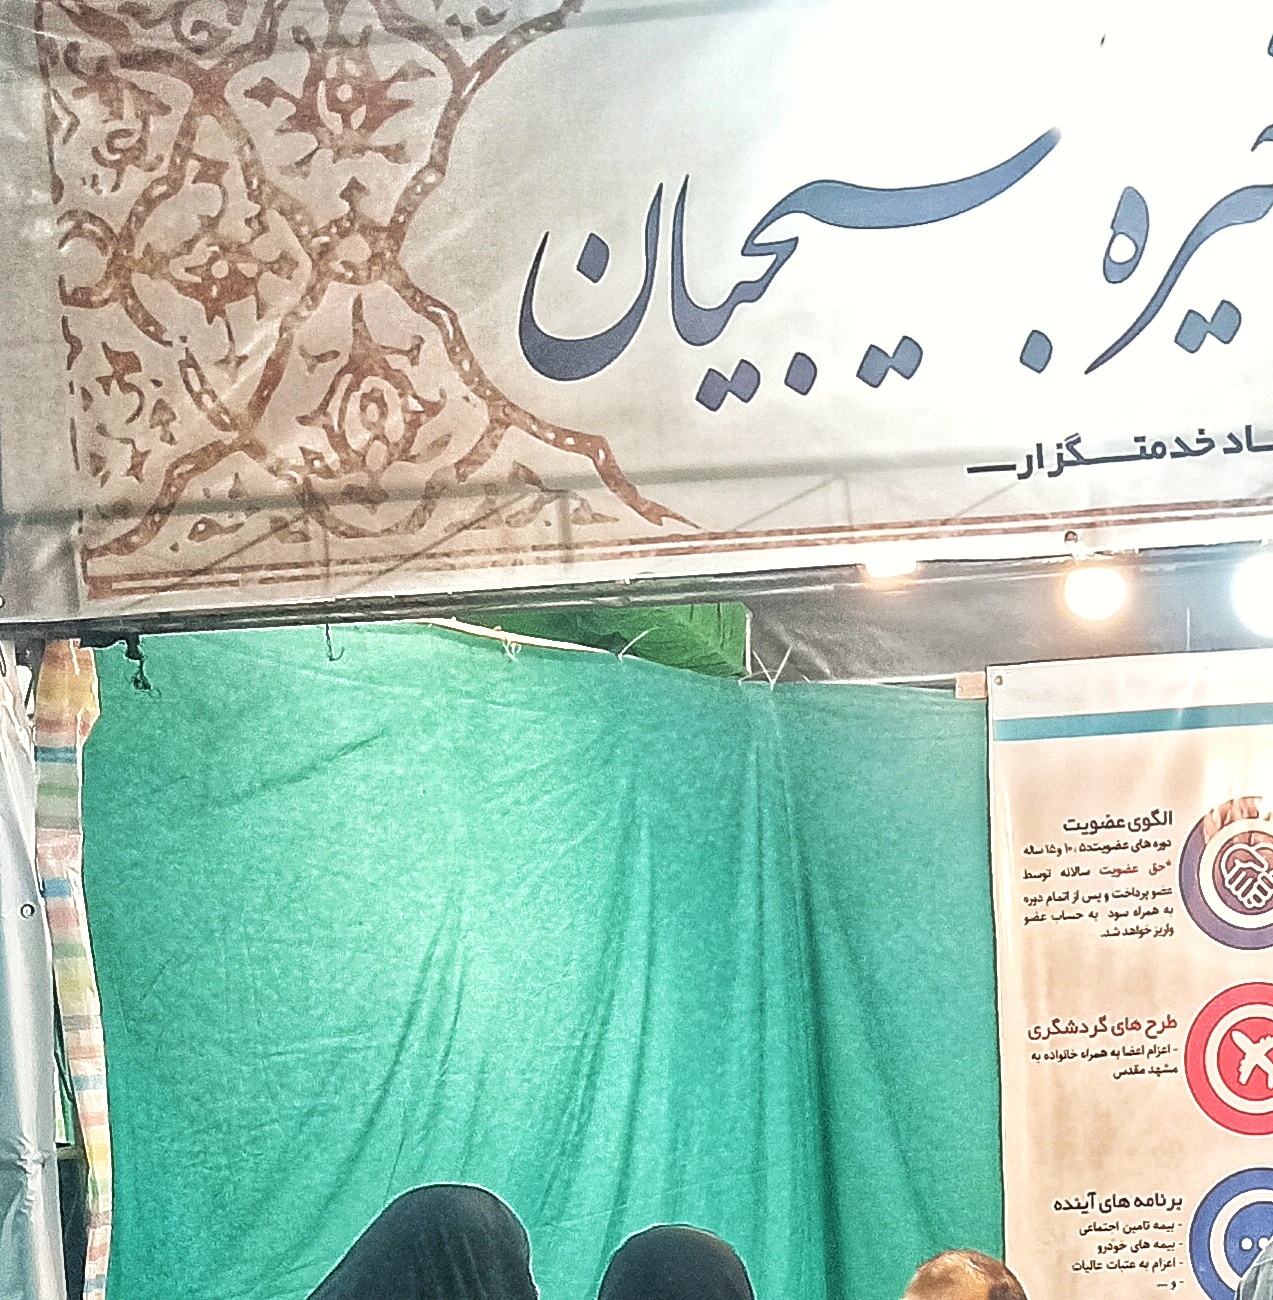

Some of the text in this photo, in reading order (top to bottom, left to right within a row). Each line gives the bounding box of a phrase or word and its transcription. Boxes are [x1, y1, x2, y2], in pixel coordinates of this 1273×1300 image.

[519, 128, 1060, 410] بسیجیان
[1017, 428, 1214, 479] خدمتگزار
[1063, 809, 1172, 835] الگوی عضویت
[1131, 839, 1151, 852] های
[1153, 840, 1171, 851] دوره
[1023, 864, 1138, 882] عضویت سالانه توسط
[1024, 895, 1043, 906] دوره
[1046, 891, 1069, 906] اتمام
[1072, 890, 1079, 904] از
[1082, 893, 1101, 904] پس
[1105, 893, 1109, 903] و
[1112, 887, 1149, 900] پرداخت
[1024, 906, 1173, 925] به همراه سود به حساب عضو
[1122, 923, 1174, 939] واریز خواهد
[1028, 1014, 1178, 1040] طرح های گردشگری
[1031, 1043, 1170, 1064] اعزام اعضا به همراه خانواده به
[1113, 1064, 1178, 1080] مشهد مقدس
[1054, 1192, 1183, 1214] برنامه های آینده
[1079, 1221, 1175, 1236] بیمه تامین اجتماعی
[1097, 1239, 1175, 1254] بیمه های خودرو
[1106, 1258, 1136, 1272] عتبات
[1139, 1259, 1149, 1269] به
[1152, 1257, 1176, 1273] اعزام
